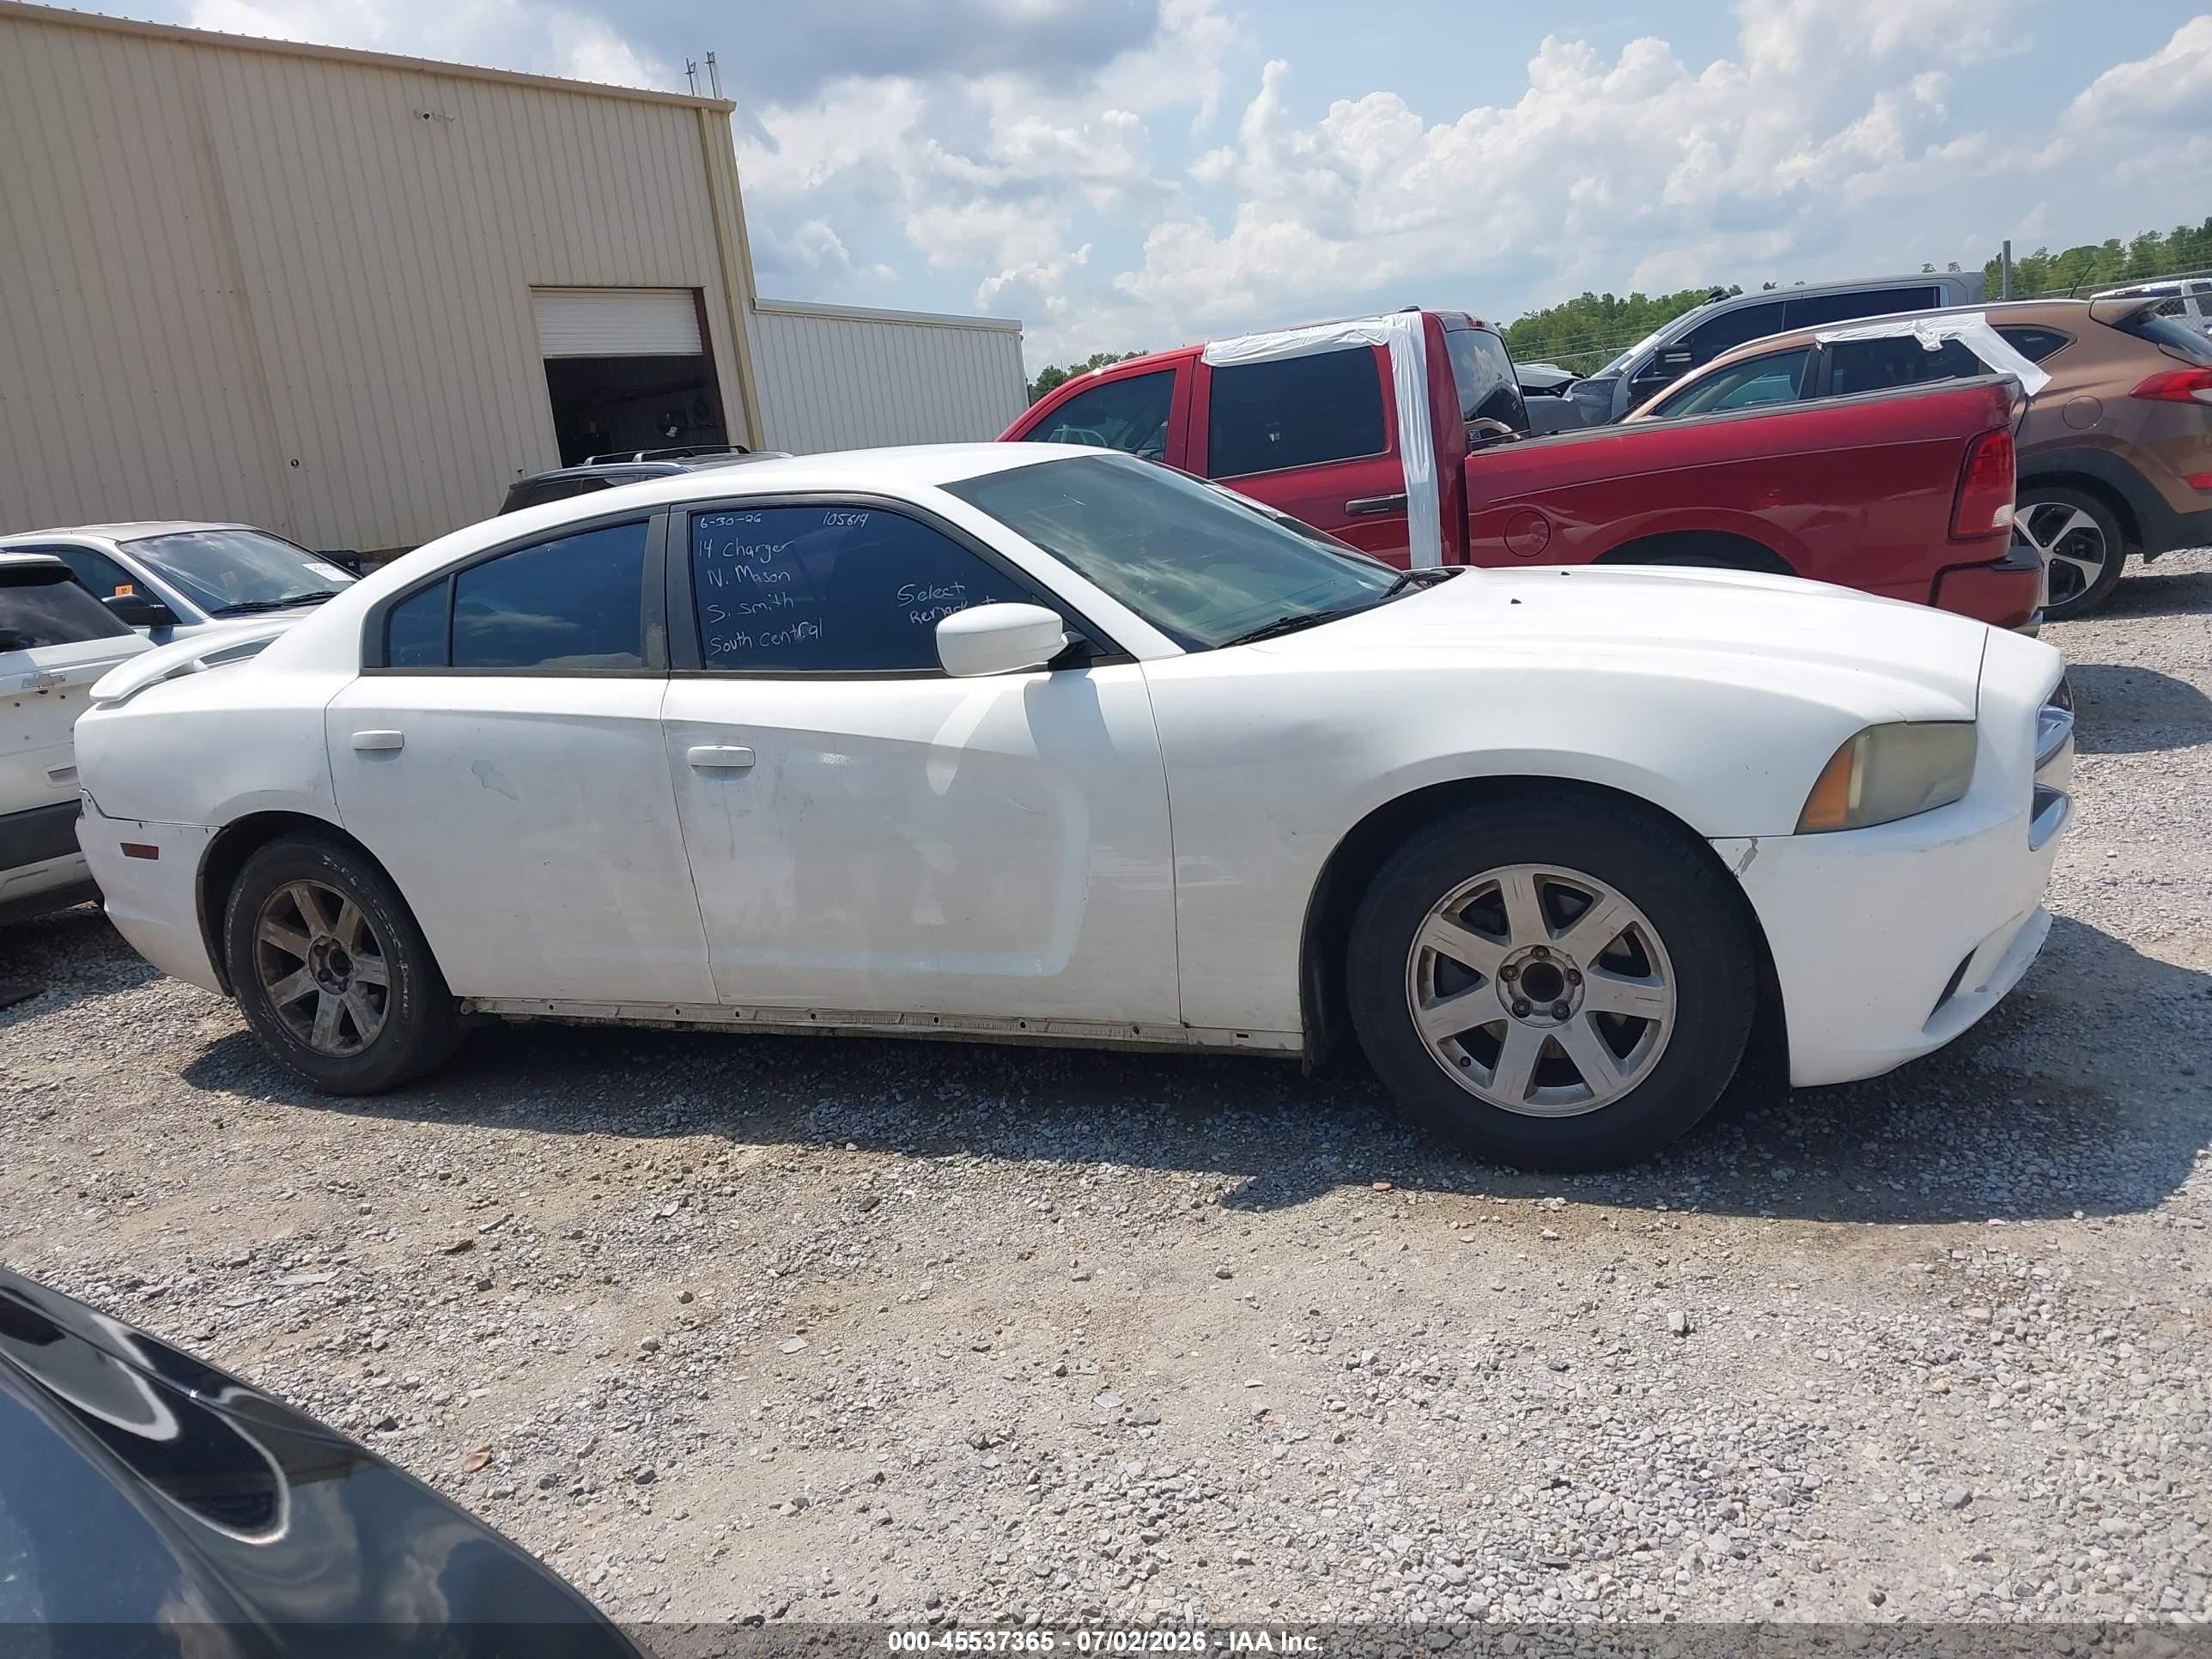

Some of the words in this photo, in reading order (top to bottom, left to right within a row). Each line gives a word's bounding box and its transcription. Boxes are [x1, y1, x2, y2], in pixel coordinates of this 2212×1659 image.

[700, 513, 763, 528] 6-30-26
[823, 511, 870, 529] 105614
[699, 538, 713, 559] 14
[722, 538, 795, 564] Charger
[707, 567, 729, 588] N.
[734, 564, 791, 584] Mason
[897, 581, 966, 608] Select
[707, 605, 731, 623] S.
[709, 631, 753, 657] South
[759, 617, 823, 647] Central
